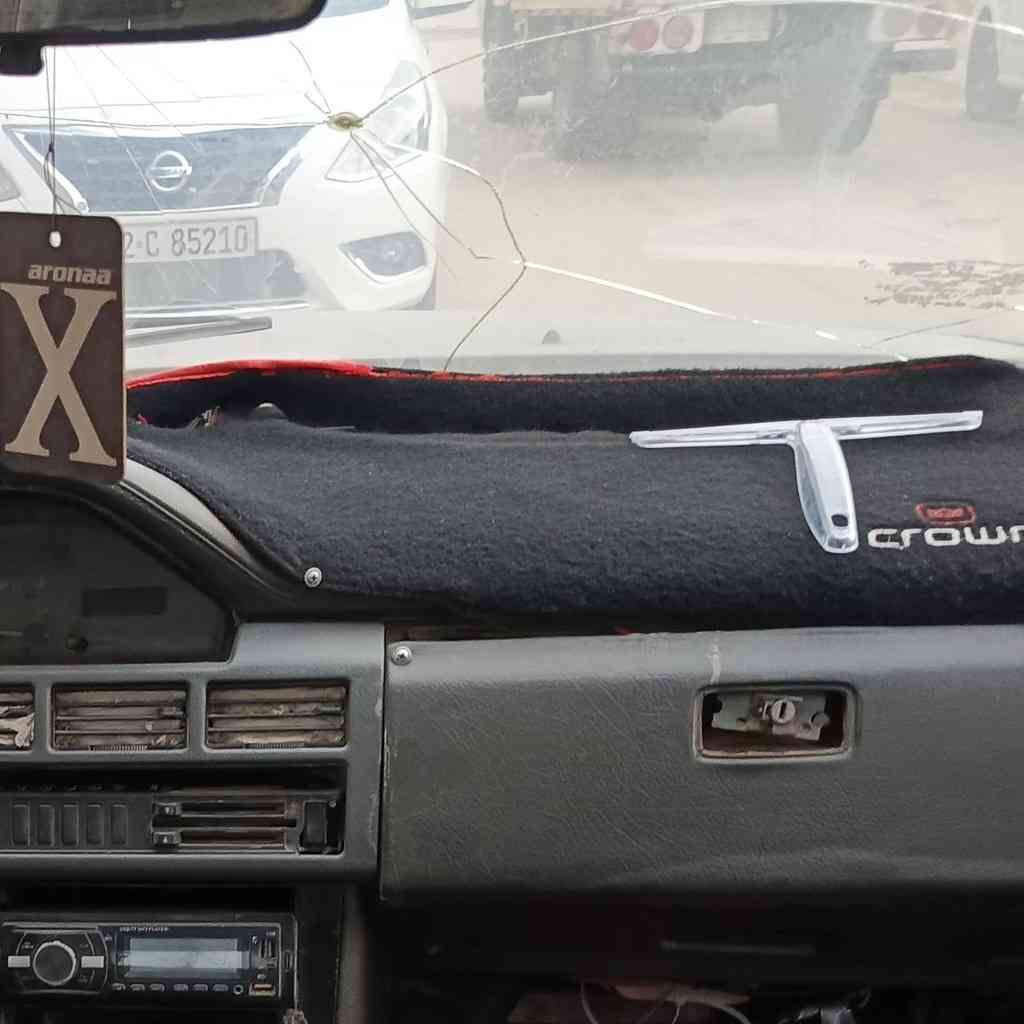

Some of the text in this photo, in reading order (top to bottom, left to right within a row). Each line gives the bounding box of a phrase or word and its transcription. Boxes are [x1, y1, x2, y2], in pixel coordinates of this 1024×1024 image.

[171, 225, 248, 257] 85210
[28, 264, 112, 285] aronaa
[0, 282, 118, 467] X
